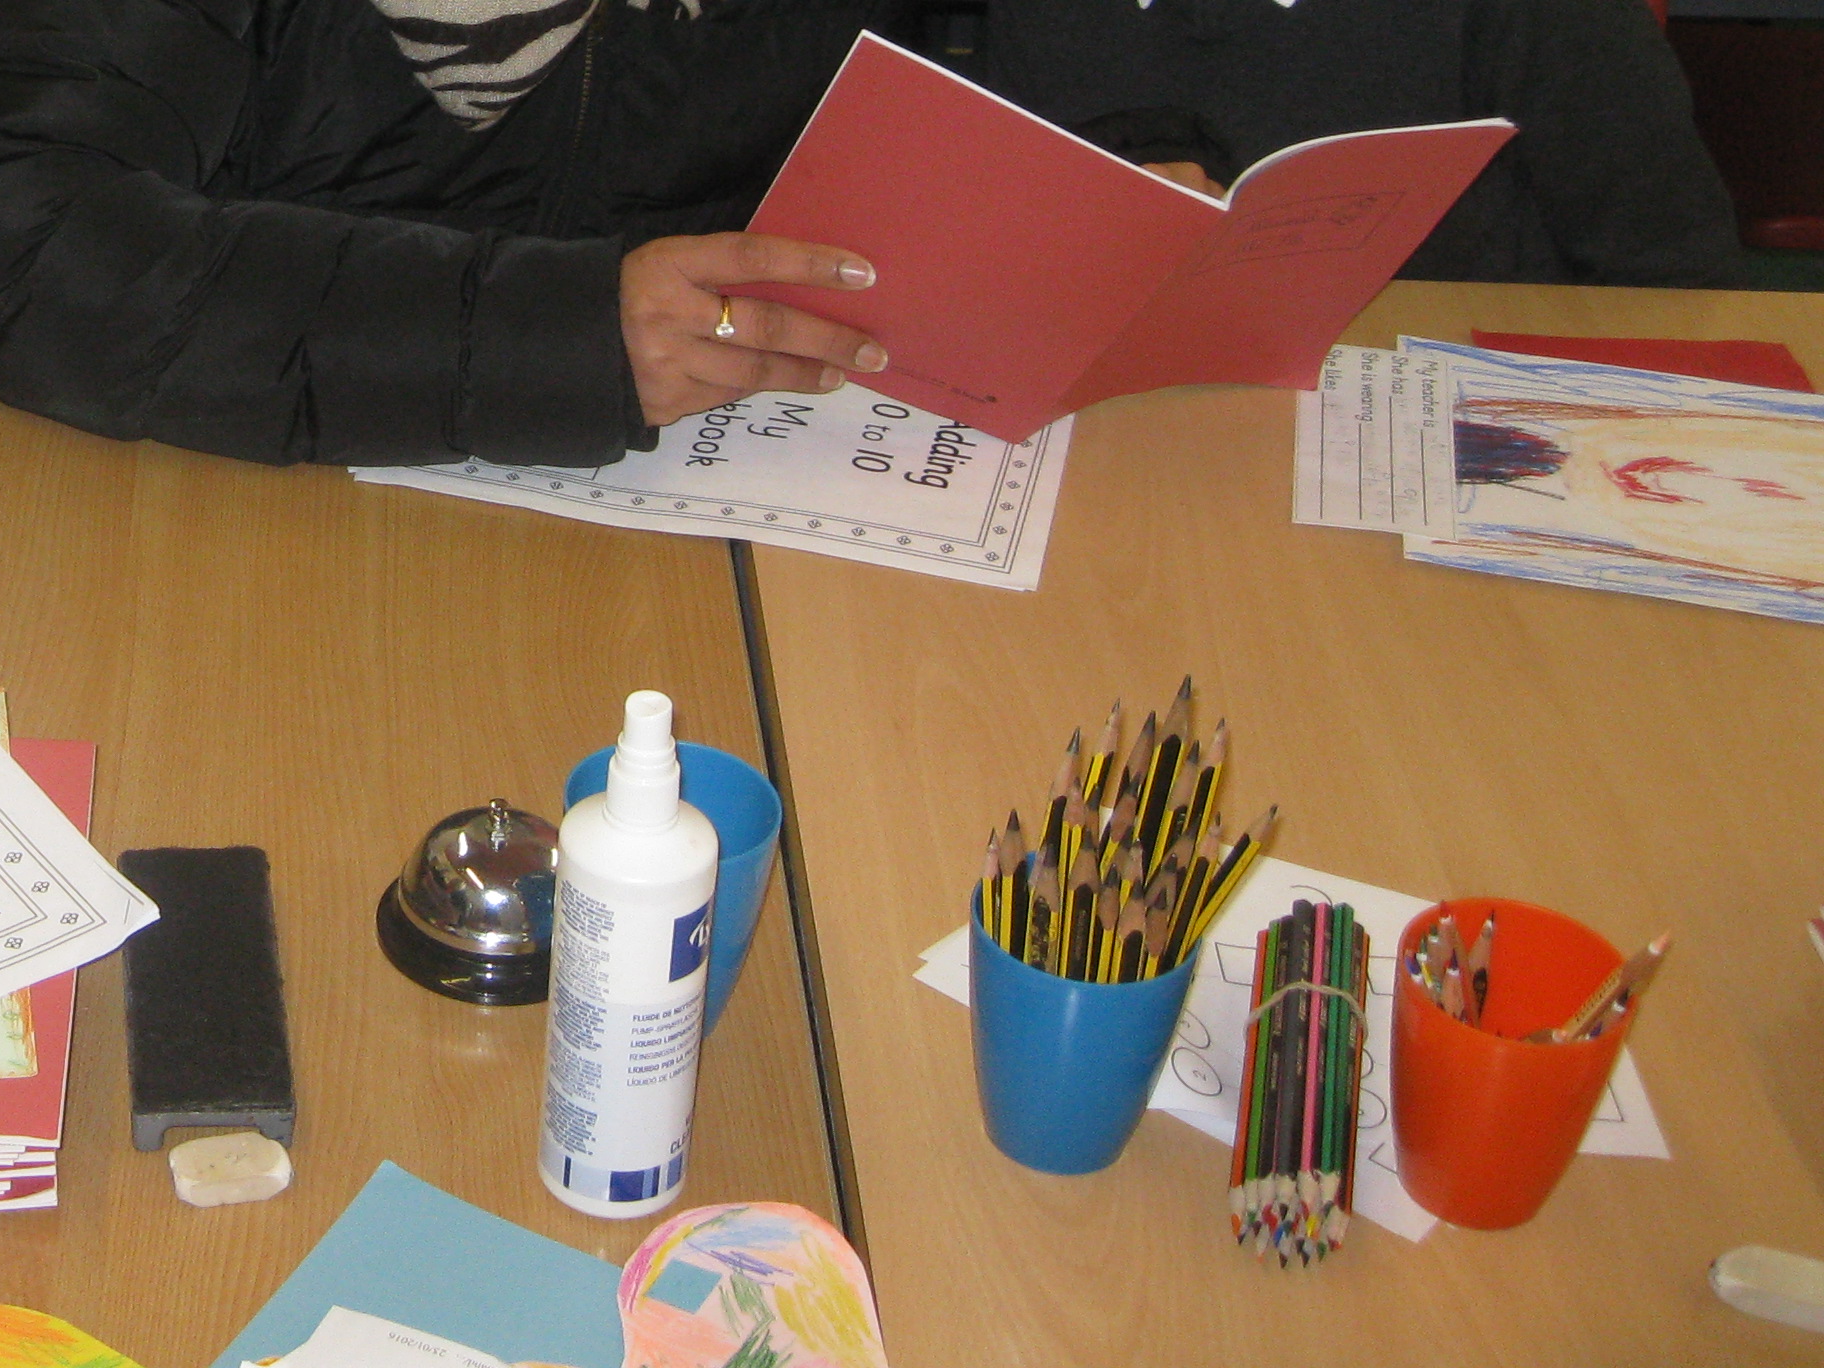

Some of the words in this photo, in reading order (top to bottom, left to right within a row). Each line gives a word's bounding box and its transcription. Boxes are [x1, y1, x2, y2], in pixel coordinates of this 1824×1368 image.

[1360, 351, 1377, 370] She
[1390, 355, 1408, 374] She
[1390, 377, 1407, 393] has
[1420, 378, 1436, 415] teacher
[748, 401, 814, 440] My
[860, 422, 891, 444] to
